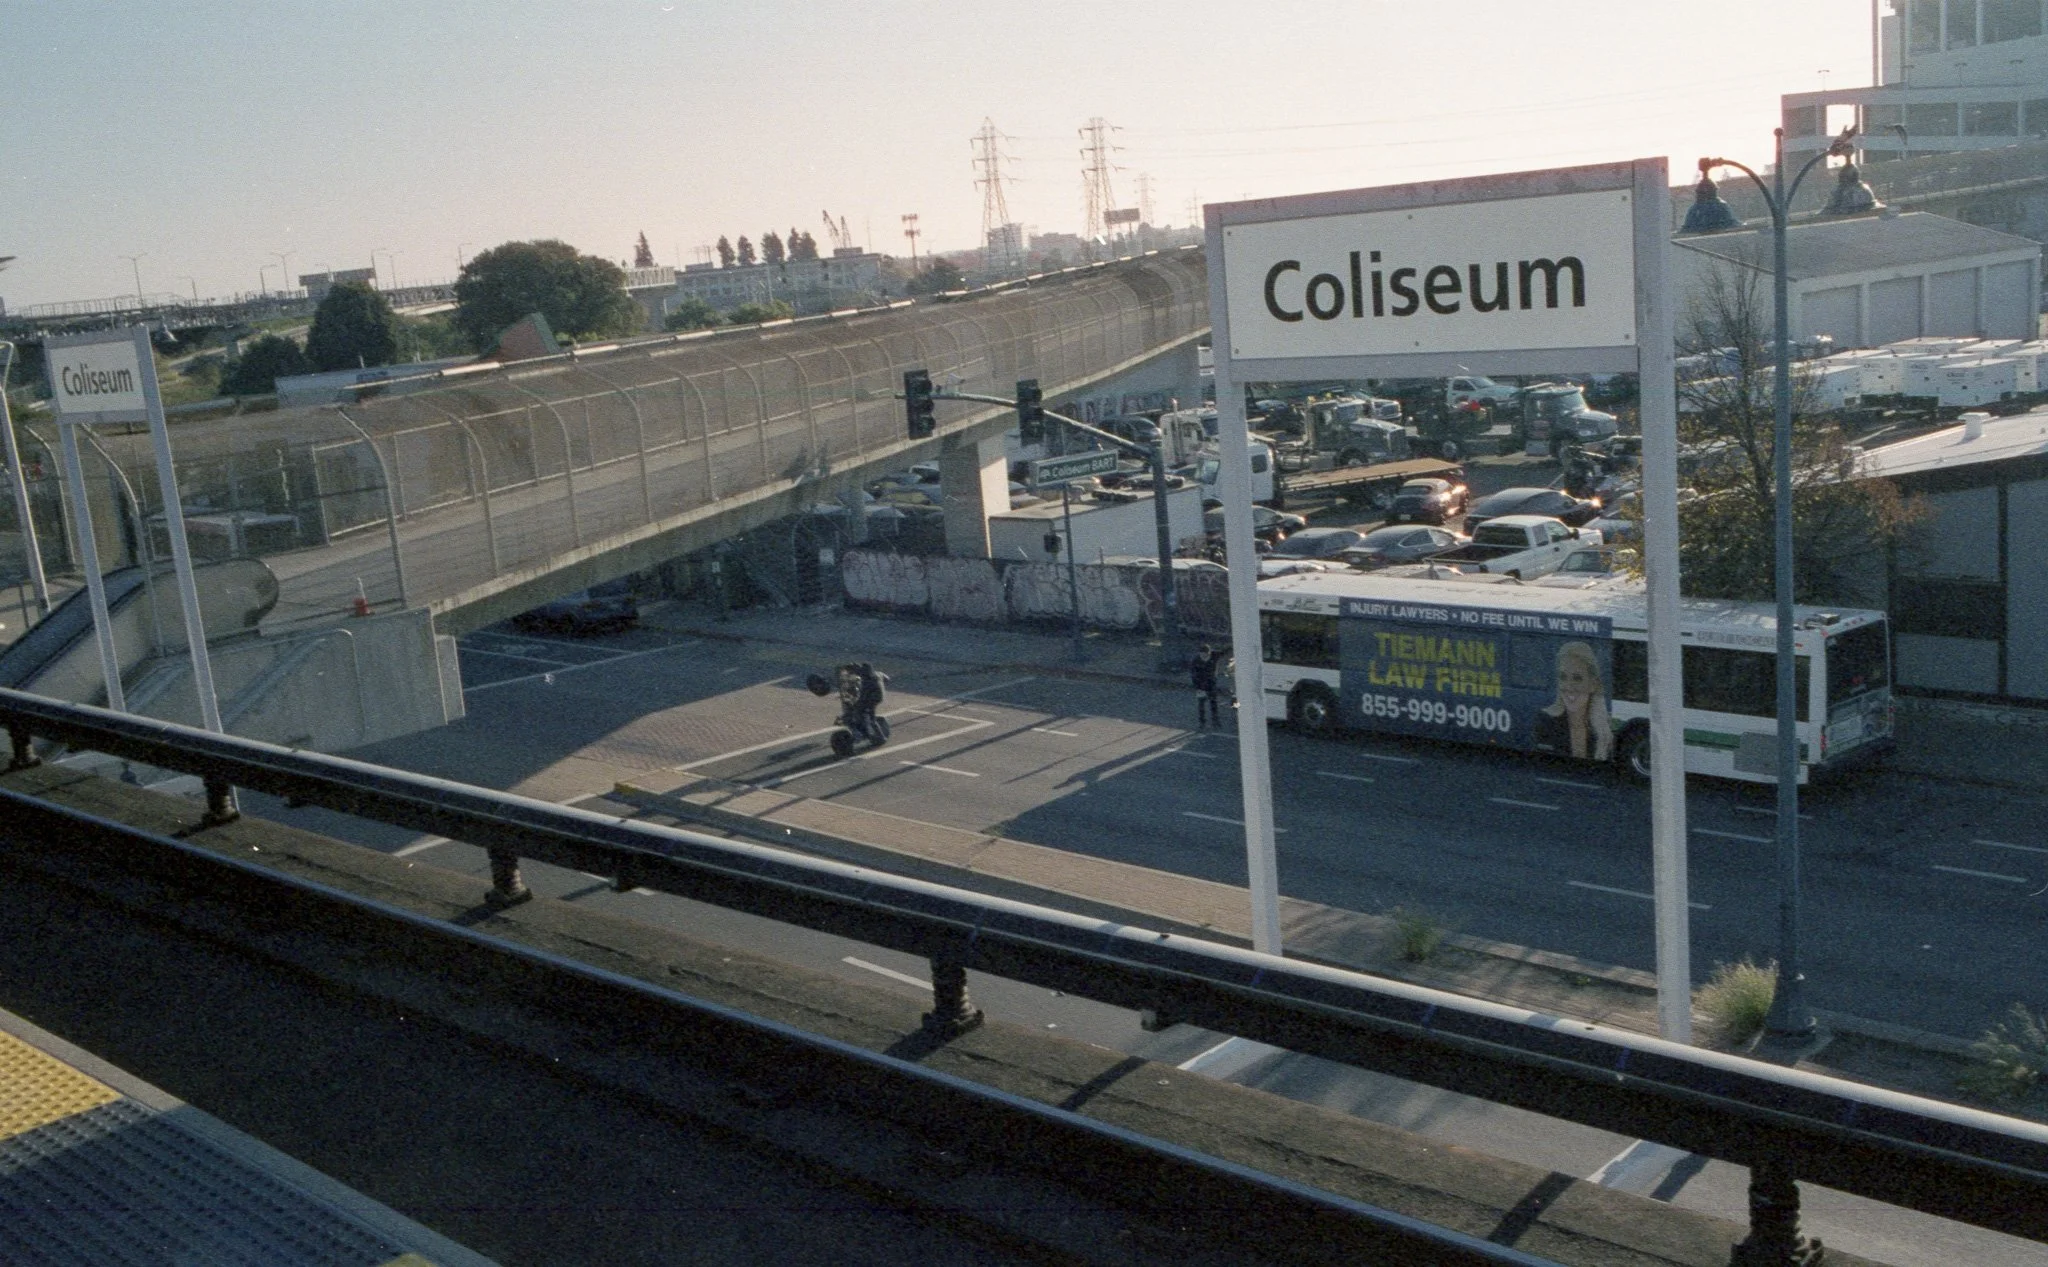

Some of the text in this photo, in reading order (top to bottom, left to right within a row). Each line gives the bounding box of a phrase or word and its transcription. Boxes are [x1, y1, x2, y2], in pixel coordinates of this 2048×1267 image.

[1264, 250, 1586, 322] Coliseum
[62, 363, 134, 396] Coliseum
[1350, 602, 1598, 633] INJURY LAWYERS NO FEE UNTIL WE WIN
[1374, 631, 1495, 668] TIEMANN
[1368, 660, 1502, 698] LAW FIRM
[1361, 693, 1511, 733] 855-999-9000
